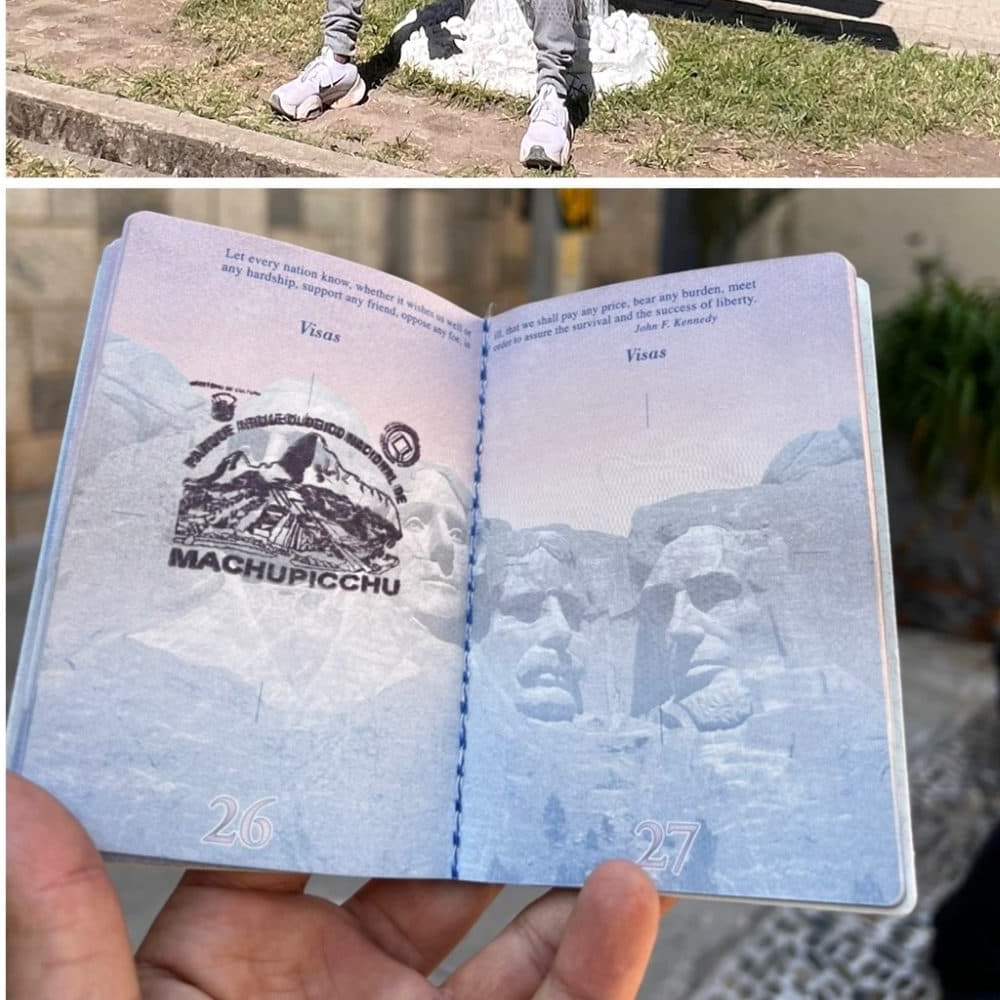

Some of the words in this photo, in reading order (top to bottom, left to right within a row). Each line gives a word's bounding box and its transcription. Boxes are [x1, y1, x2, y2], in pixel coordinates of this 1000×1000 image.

[221, 262, 244, 277] any
[246, 267, 299, 289] hardship,
[302, 282, 343, 300] support
[345, 294, 364, 308] any
[367, 299, 399, 318] friend,
[401, 312, 432, 330] oppose
[432, 325, 446, 338] any
[225, 248, 245, 261] Let
[248, 255, 280, 271] every
[283, 263, 318, 279] nation
[321, 271, 353, 290] know,
[356, 284, 394, 302] whether
[407, 300, 434, 319] wishes
[447, 319, 463, 333] well
[506, 325, 520, 335] that
[522, 320, 535, 329] we
[537, 313, 559, 326] shall
[561, 310, 579, 323] pay
[581, 306, 599, 317] any
[601, 300, 631, 315] price,
[633, 296, 656, 307] bear
[659, 290, 679, 303] any
[681, 285, 725, 299] burden,
[728, 280, 757, 292] meet
[300, 320, 341, 343] Visas
[513, 336, 523, 345] to
[524, 329, 553, 342] assure
[554, 324, 570, 336] the
[572, 313, 612, 332] survival
[614, 311, 634, 324] and
[636, 309, 653, 320] the
[655, 303, 698, 316] success
[700, 298, 713, 310] of
[716, 294, 758, 308] liberty.
[634, 322, 658, 334] John
[661, 319, 671, 329] F.
[673, 312, 719, 328] Kennedy
[626, 348, 667, 363] Visas
[168, 547, 400, 596] MACHUPICCHU
[201, 795, 279, 849] 26
[634, 820, 701, 876] 27
